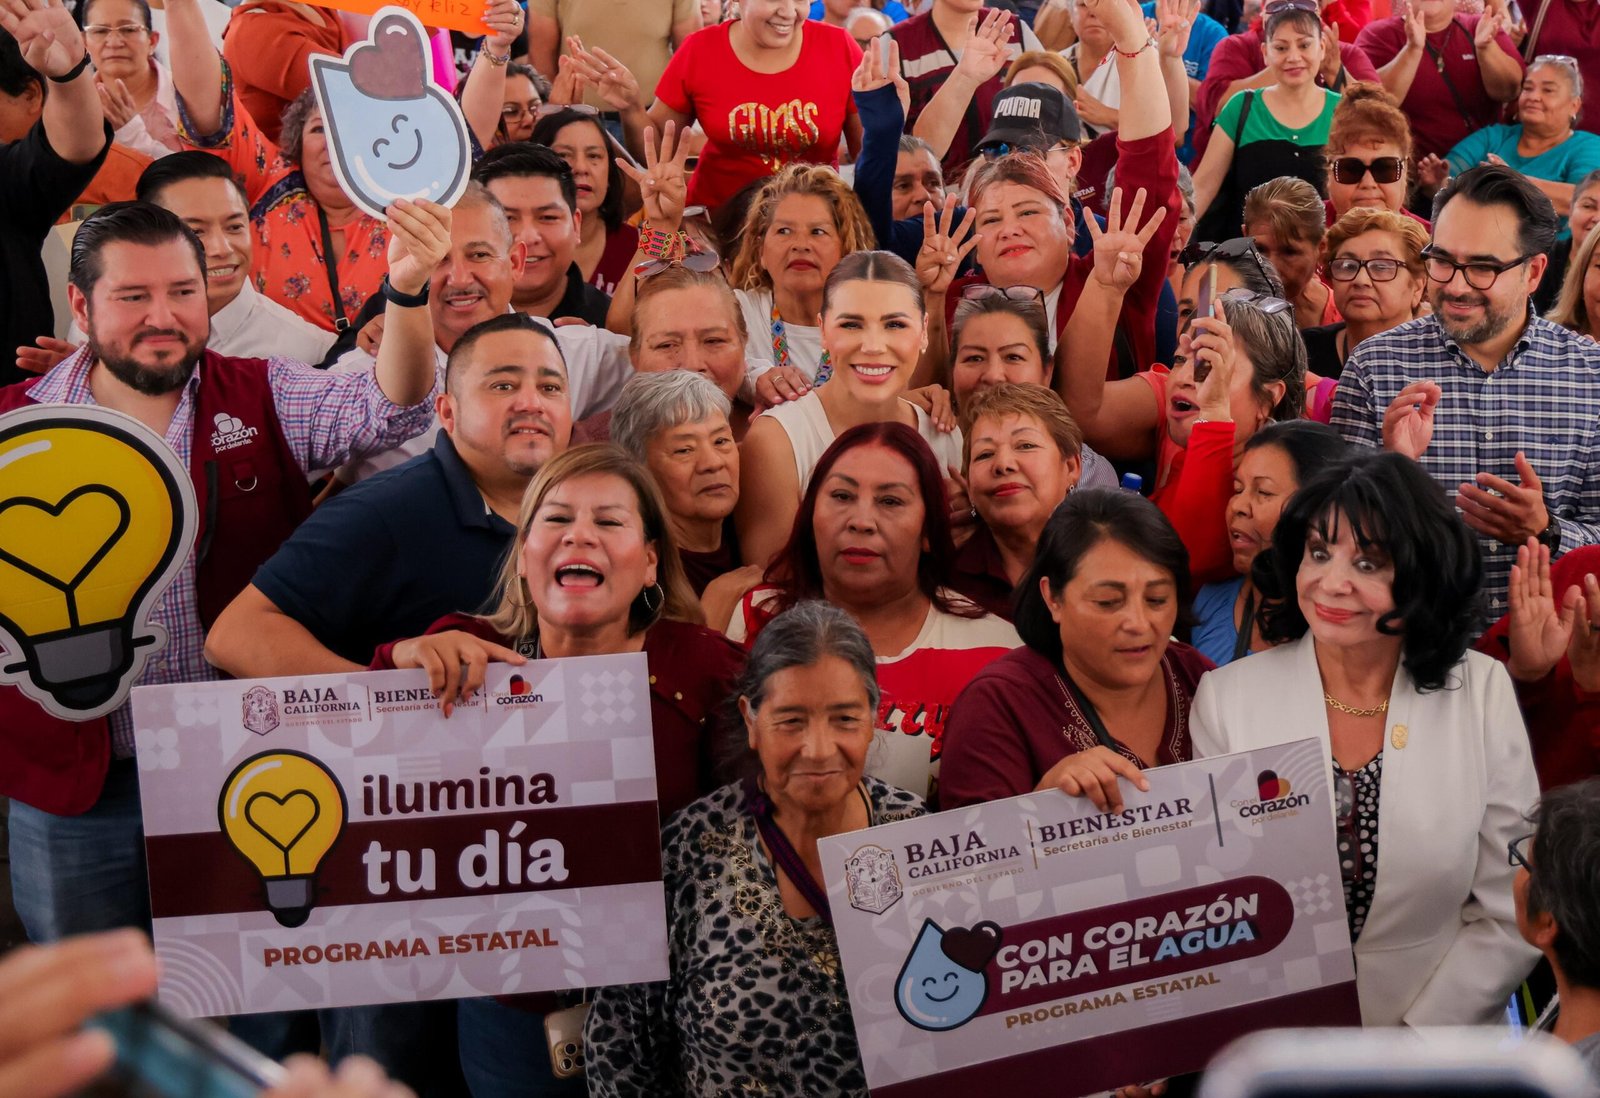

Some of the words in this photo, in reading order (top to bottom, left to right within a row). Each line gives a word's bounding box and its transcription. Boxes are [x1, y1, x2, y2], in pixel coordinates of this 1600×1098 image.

[994, 96, 1041, 119] PUMA
[283, 687, 338, 704] BAJA
[284, 702, 360, 715] CALIFORNIA
[423, 702, 435, 710] de
[496, 691, 543, 705] corazón
[363, 766, 558, 816] ilumina
[1239, 791, 1310, 818] corazón
[1038, 798, 1193, 843] BIENESTAR
[1112, 831, 1128, 842] de
[1131, 819, 1193, 839] Bienestar
[362, 840, 436, 895] tu
[458, 820, 569, 889] día
[904, 830, 987, 865] BAJA
[908, 845, 1021, 879] CALIFORNIA
[912, 880, 962, 897] GOBIERNO
[966, 874, 984, 885] DEL
[987, 867, 1025, 880] ESTADO
[263, 937, 431, 968] PROGRAMA
[438, 928, 559, 955] ESTATAL
[995, 932, 1073, 969] CON
[1083, 893, 1259, 950] CORAZÓN
[1001, 953, 1099, 994] PARA
[1108, 943, 1150, 971] EL
[1153, 920, 1255, 962] AGUA
[1005, 991, 1128, 1029] PROGRAMA
[1132, 971, 1222, 1001] ESTATAL
